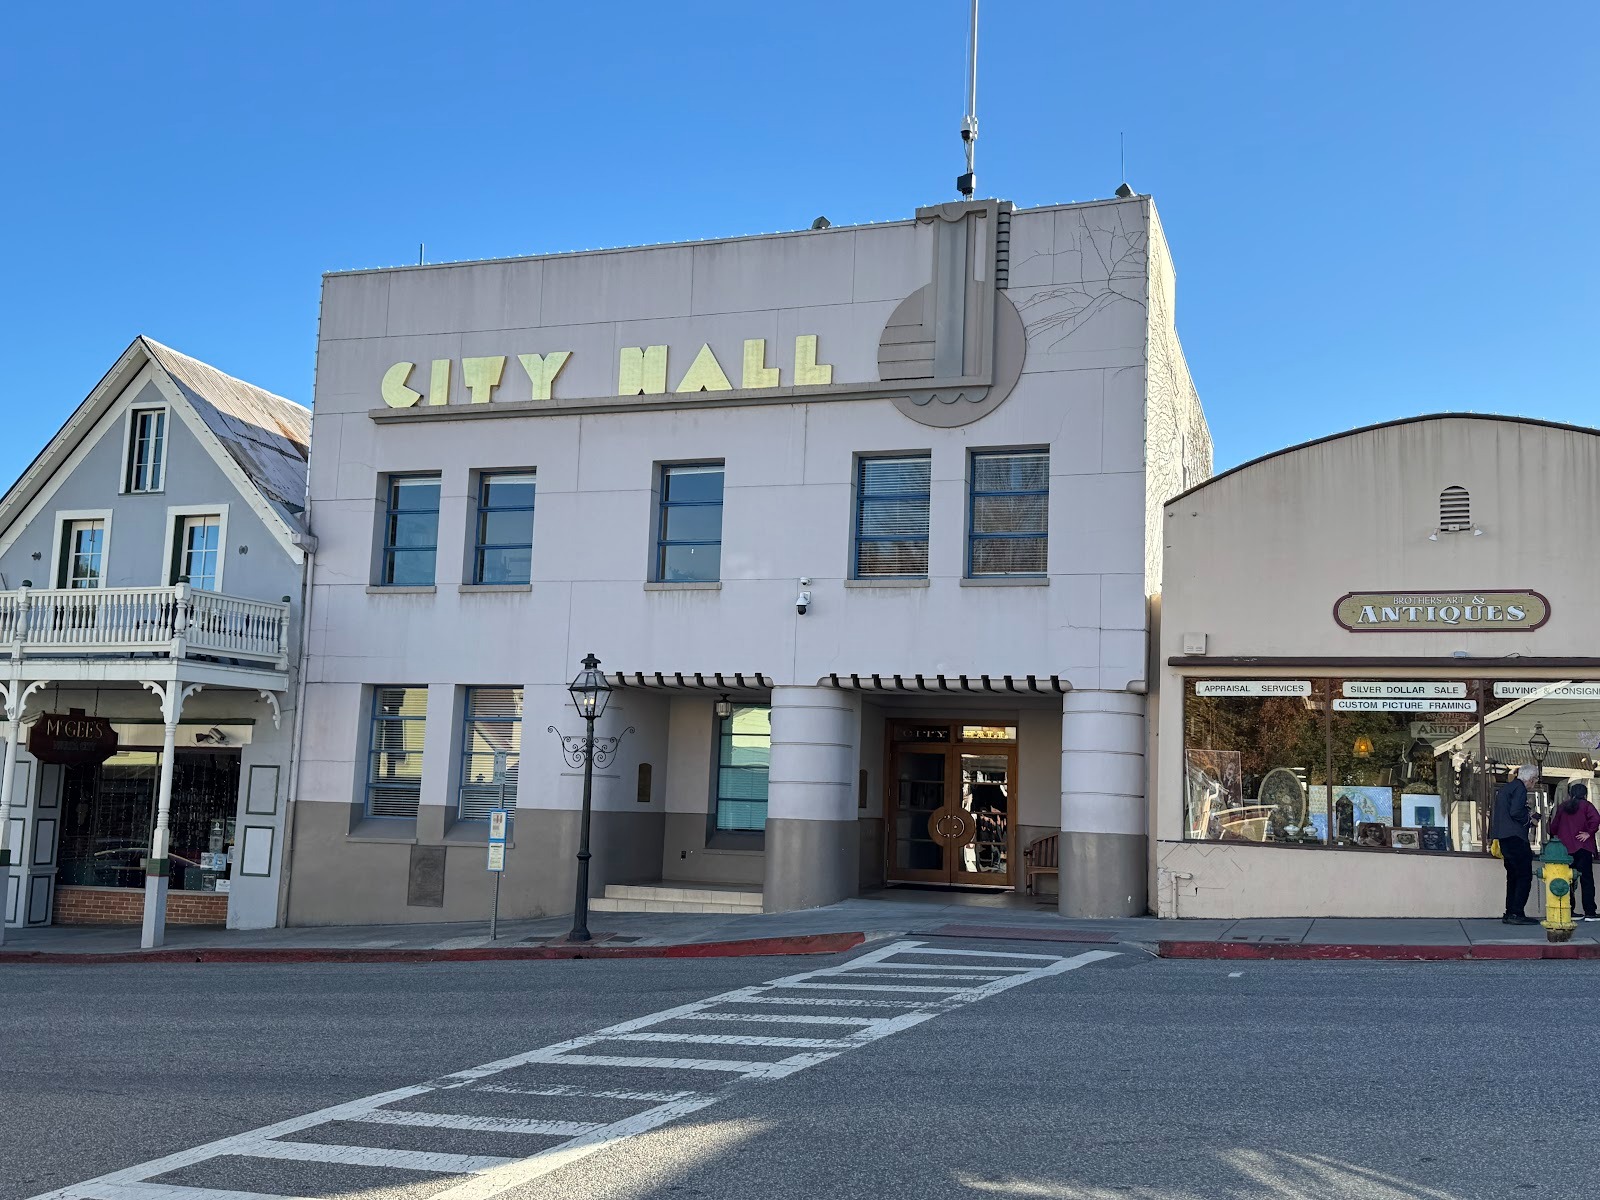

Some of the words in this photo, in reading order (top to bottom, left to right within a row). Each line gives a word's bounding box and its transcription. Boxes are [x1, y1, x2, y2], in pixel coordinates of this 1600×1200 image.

[381, 351, 573, 408] CITY
[619, 335, 833, 396] HALL
[1393, 596, 1442, 605] BROTHERS
[1445, 596, 1464, 604] ART
[1471, 595, 1486, 605] &
[1356, 605, 1527, 625] ANTIQUES
[1204, 684, 1251, 693] APPRAISAL
[1261, 684, 1304, 693] SERVICES
[1350, 685, 1382, 694] SILVER
[1386, 686, 1425, 694] DOLLAR
[1434, 686, 1459, 695] SALE
[1501, 686, 1538, 696] BUYING
[1554, 687, 1600, 695] CONSIGN
[1338, 701, 1378, 709] CUSTOM
[1382, 702, 1423, 710] PICTURE
[1429, 702, 1472, 710] FRAMING
